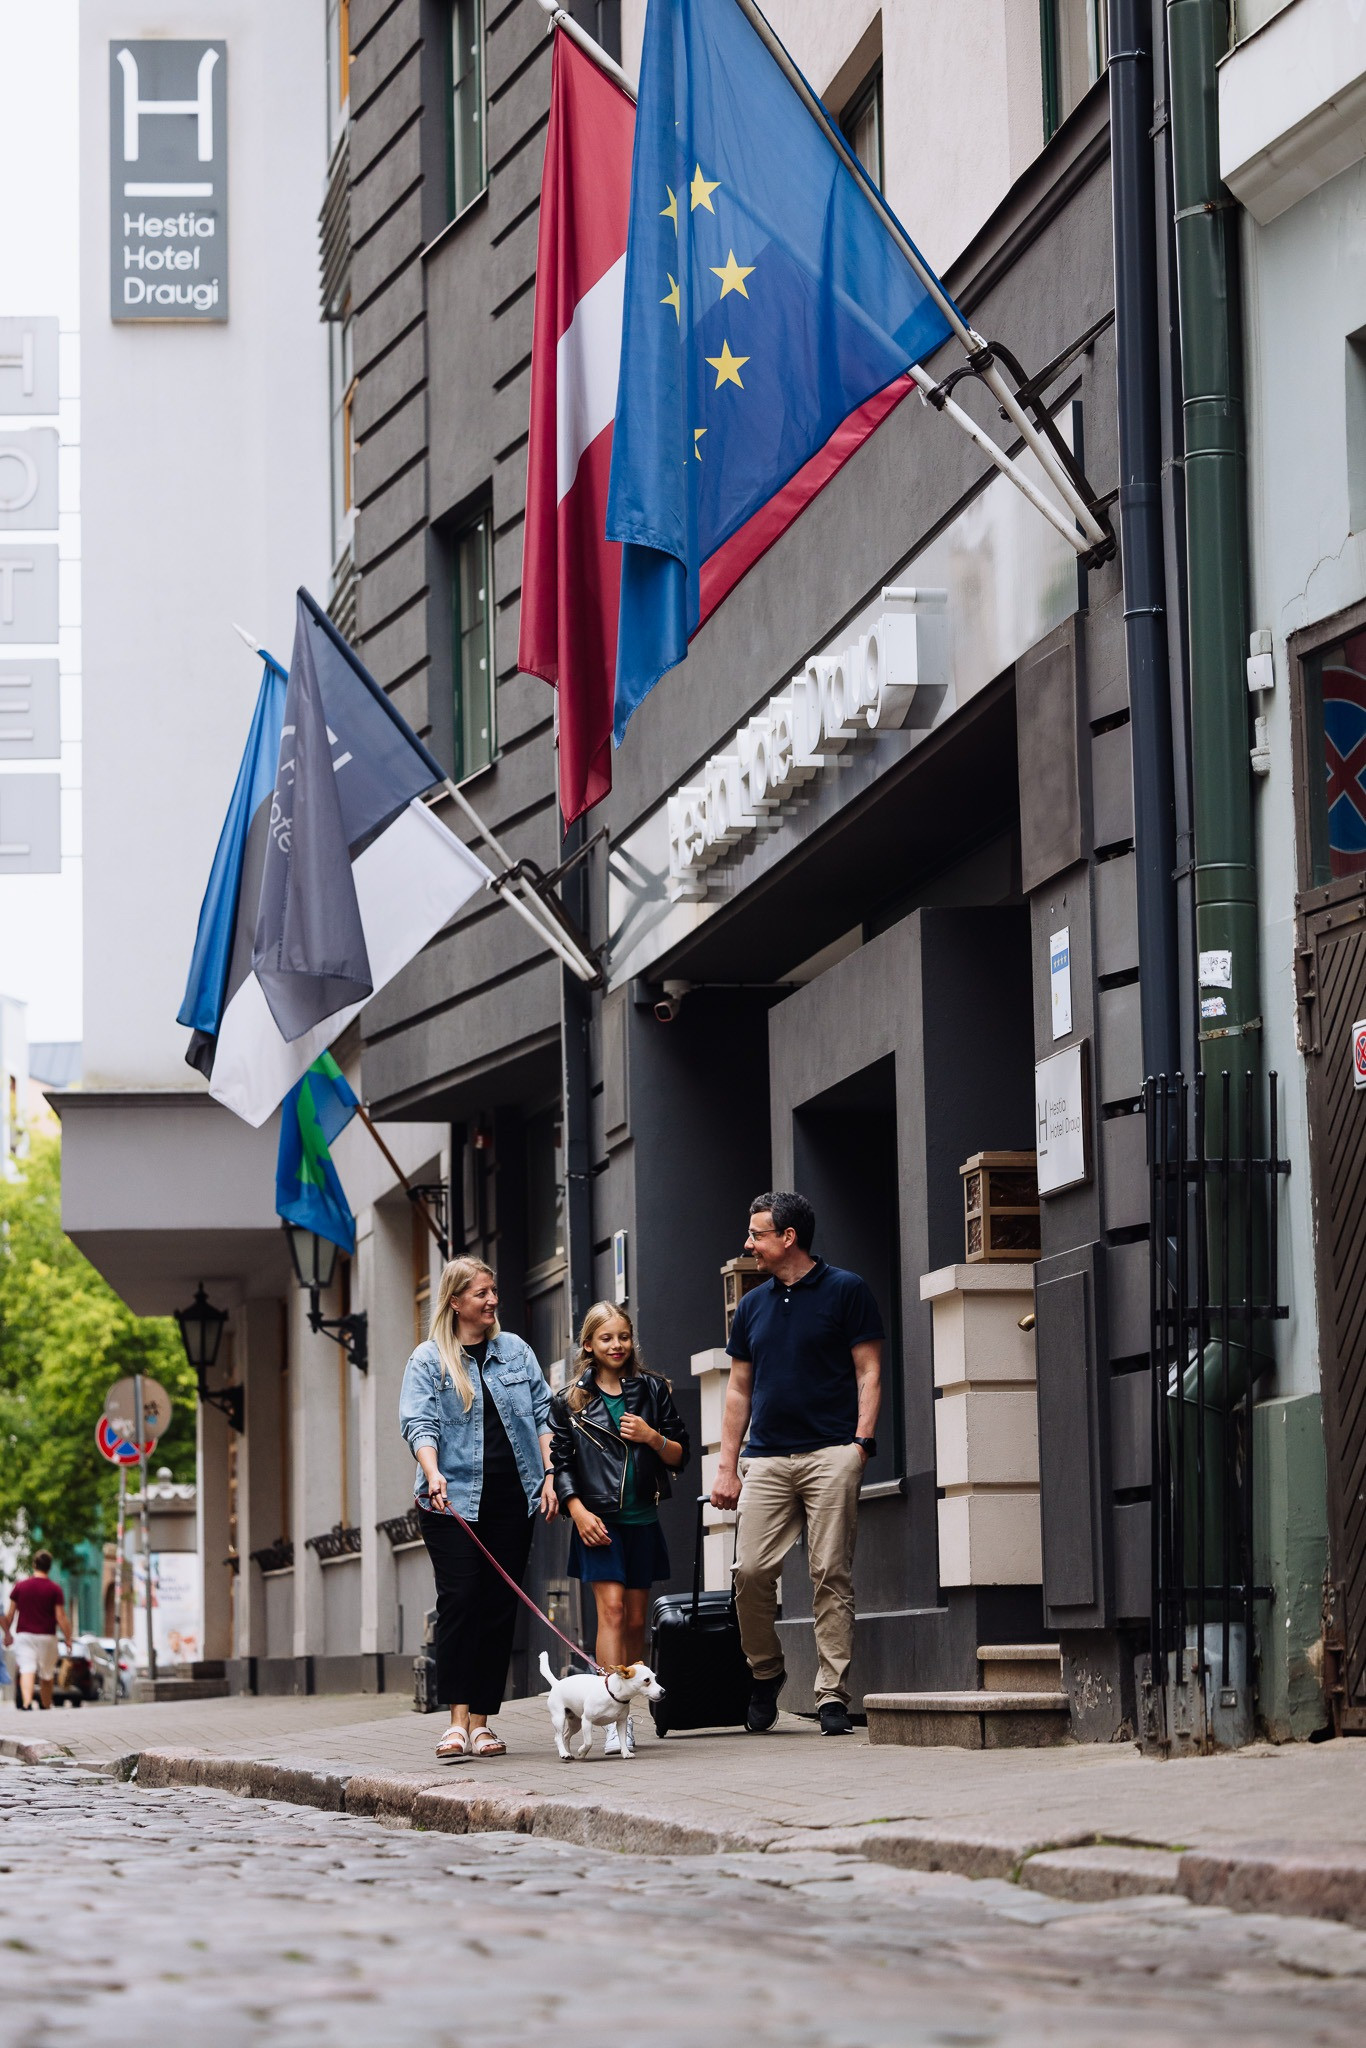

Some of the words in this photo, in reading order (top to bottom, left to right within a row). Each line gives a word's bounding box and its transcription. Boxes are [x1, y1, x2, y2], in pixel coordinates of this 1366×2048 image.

[123, 212, 215, 237] Hestia
[123, 245, 200, 270] Hotel
[123, 277, 219, 311] Draugi
[1049, 1097, 1067, 1118] Hestia
[1049, 1119, 1064, 1140] Hotel
